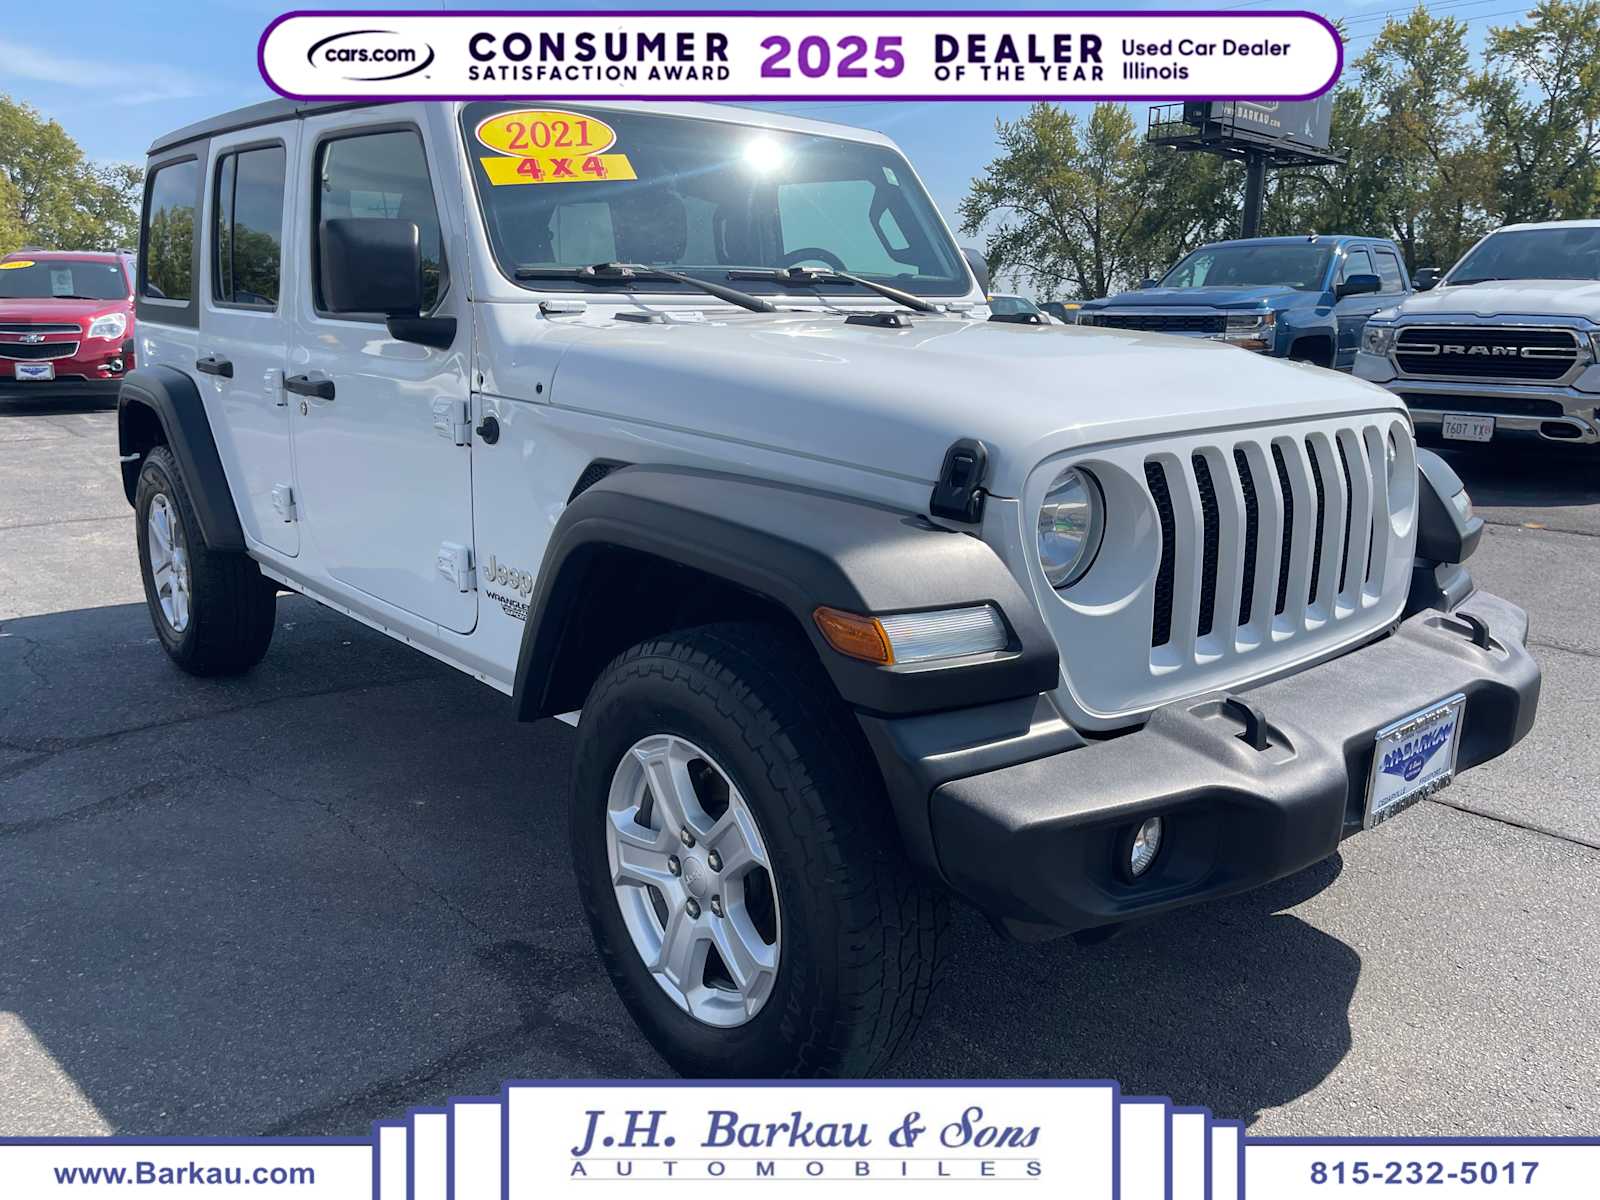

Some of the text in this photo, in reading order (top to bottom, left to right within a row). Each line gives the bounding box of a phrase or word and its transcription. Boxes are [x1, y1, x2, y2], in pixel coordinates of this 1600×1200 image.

[506, 120, 593, 150] 2021
[1443, 345, 1518, 356] RAM
[1445, 422, 1469, 434] 7607
[483, 553, 533, 598] Jeep
[486, 590, 530, 609] WRANGLE
